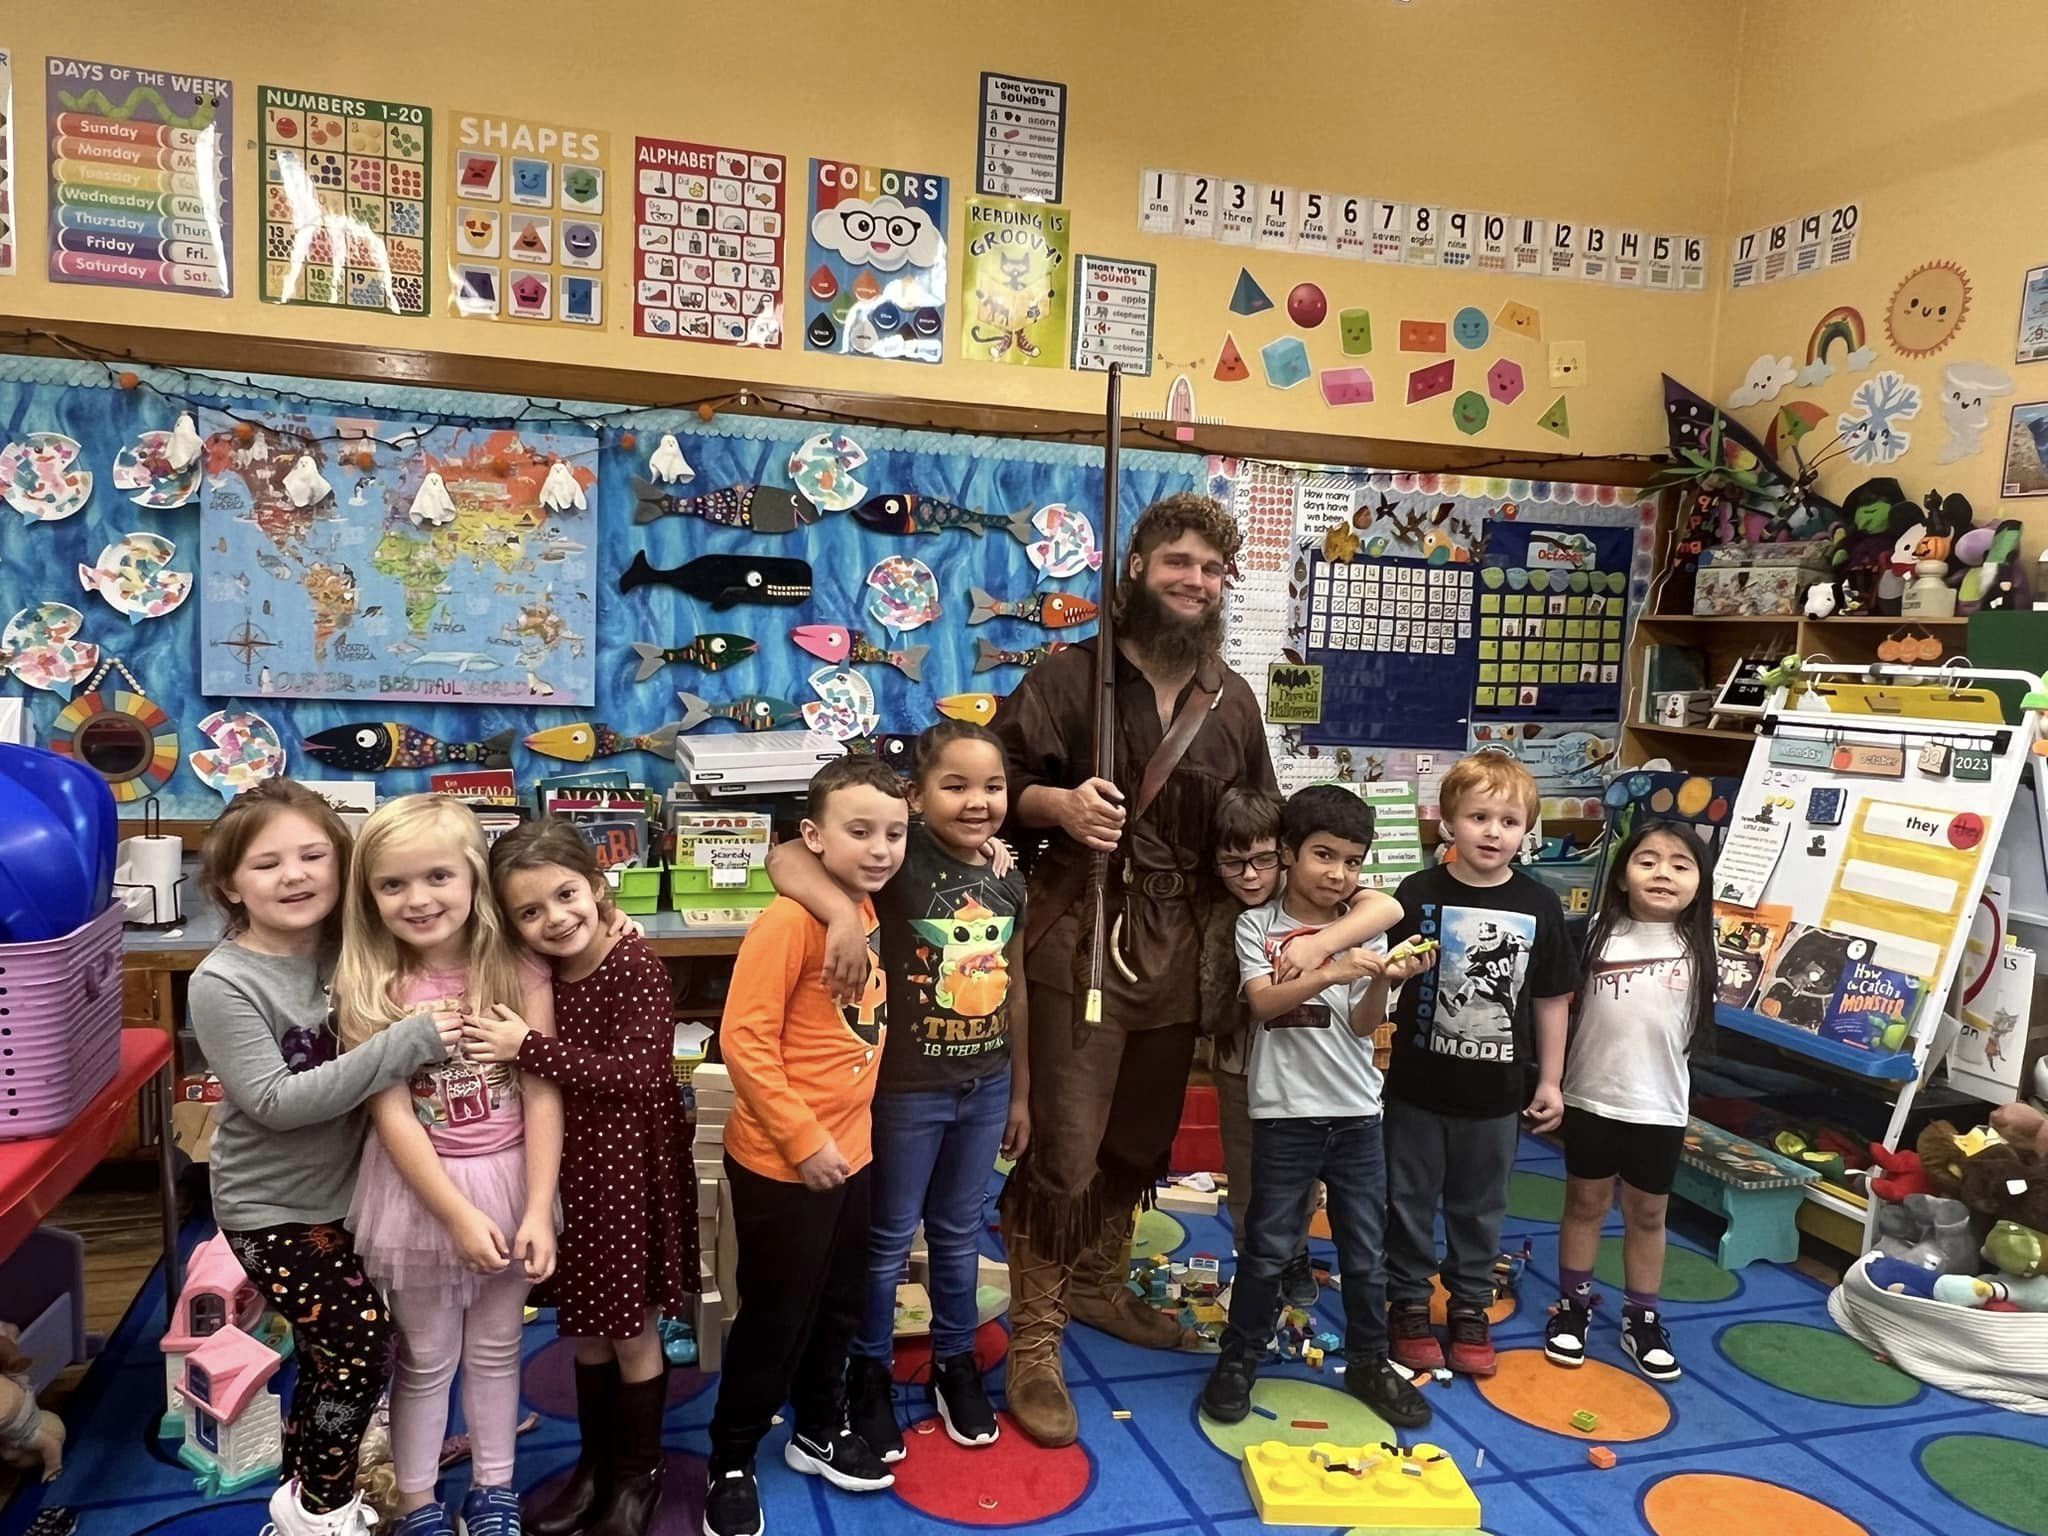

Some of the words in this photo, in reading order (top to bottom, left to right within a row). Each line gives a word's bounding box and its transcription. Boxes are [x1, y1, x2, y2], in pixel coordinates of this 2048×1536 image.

[50, 59, 104, 81] DAYS
[110, 68, 129, 80] OF
[136, 71, 165, 86] THE
[171, 75, 229, 98] WEEK
[995, 81, 1020, 92] LONG
[1023, 85, 1055, 97] VOWEL
[1001, 91, 1046, 106] SOUNDS
[266, 89, 366, 116] NUMBERS
[382, 105, 423, 123] 1-20
[81, 121, 138, 140] Sunday
[269, 110, 275, 122] 1
[310, 117, 318, 127] 2
[391, 127, 399, 137] 4
[459, 116, 600, 161] SHAPES
[78, 143, 140, 163] Monday
[269, 150, 277, 160] 5
[310, 154, 318, 165] 6
[351, 160, 358, 170] 7
[390, 164, 398, 175] 8
[639, 146, 715, 170] ALPHABET
[78, 168, 141, 187] Tuesday
[820, 164, 938, 200] COLORS
[64, 186, 155, 210] Wednesday
[270, 188, 279, 198] 9
[350, 197, 361, 208] 11
[390, 202, 403, 213] 12
[74, 211, 144, 233] Thursday
[972, 206, 1042, 229] READING
[1051, 216, 1064, 231] IS
[1149, 204, 1168, 212] one
[1189, 205, 1208, 217] two
[1223, 211, 1252, 224] three
[1265, 215, 1286, 228] four
[1303, 220, 1323, 232] five
[1156, 174, 1162, 199] 1
[1194, 179, 1208, 204] 2
[1232, 185, 1245, 209] 3
[1271, 190, 1284, 216] 4
[1308, 195, 1321, 219] 5
[1344, 199, 1357, 223] 6
[1382, 205, 1394, 228] 7
[1417, 208, 1429, 231] 8
[1451, 214, 1466, 238] 9
[1485, 216, 1503, 240] 10
[1524, 220, 1532, 243] 11
[1556, 224, 1570, 247] 12
[1588, 228, 1604, 252] 13
[1622, 233, 1638, 257] 14
[1654, 237, 1668, 260] 15
[1685, 239, 1700, 261] 16
[1739, 235, 1754, 259] 17
[1770, 226, 1786, 251] 18
[1801, 216, 1820, 243] 19
[1831, 205, 1857, 234] 20
[86, 235, 134, 253] Friday
[186, 248, 208, 259] Fri.
[269, 226, 284, 238] 13
[390, 241, 404, 251] 16
[970, 229, 1062, 267] GROOVY!
[76, 258, 146, 278] Saturday
[184, 269, 211, 282] Sat.
[310, 269, 325, 280] 18
[351, 273, 365, 284] 19
[391, 277, 408, 288] 20
[1087, 262, 1114, 272] SHORT
[1118, 267, 1147, 276] VOWEL
[1094, 272, 1137, 285] SOUNDS
[1121, 295, 1146, 304] apple
[1239, 489, 1249, 497] 20
[1304, 488, 1323, 498] How
[1325, 492, 1350, 502] many
[1304, 501, 1324, 511] days
[1327, 502, 1348, 511] have
[1323, 513, 1344, 522] been
[1305, 523, 1311, 532] in
[1236, 553, 1246, 562] 50
[1338, 567, 1344, 576] 2
[1355, 569, 1360, 577] 3
[1401, 570, 1407, 580] 6
[1416, 571, 1423, 580] 7
[1448, 573, 1454, 582] 9
[1234, 594, 1244, 603] 70
[1352, 585, 1362, 594] 13
[1446, 590, 1456, 599] 19
[1314, 600, 1325, 610] 21
[1333, 601, 1345, 610] 22
[1349, 602, 1359, 611] 23
[1413, 605, 1424, 614] 27
[1314, 618, 1324, 629] 31
[1333, 619, 1344, 629] 32
[1349, 620, 1360, 629] 33
[1413, 624, 1424, 633] 37
[1231, 639, 1242, 647] 90
[1311, 636, 1322, 644] 41
[1279, 688, 1303, 703] Days
[1270, 702, 1318, 719] Halloween
[1921, 747, 1941, 764] 30
[1955, 756, 1989, 771] 2023
[1906, 816, 1939, 837] they
[711, 849, 751, 859] Scaredy
[1854, 963, 1882, 979] How
[1859, 979, 1894, 996] Catch
[1839, 993, 1905, 1018] MONSTER
[923, 1043, 942, 1056] IS
[947, 1045, 980, 1057] THE
[984, 1037, 1004, 1052] WA
[1434, 1036, 1514, 1062] MODE
